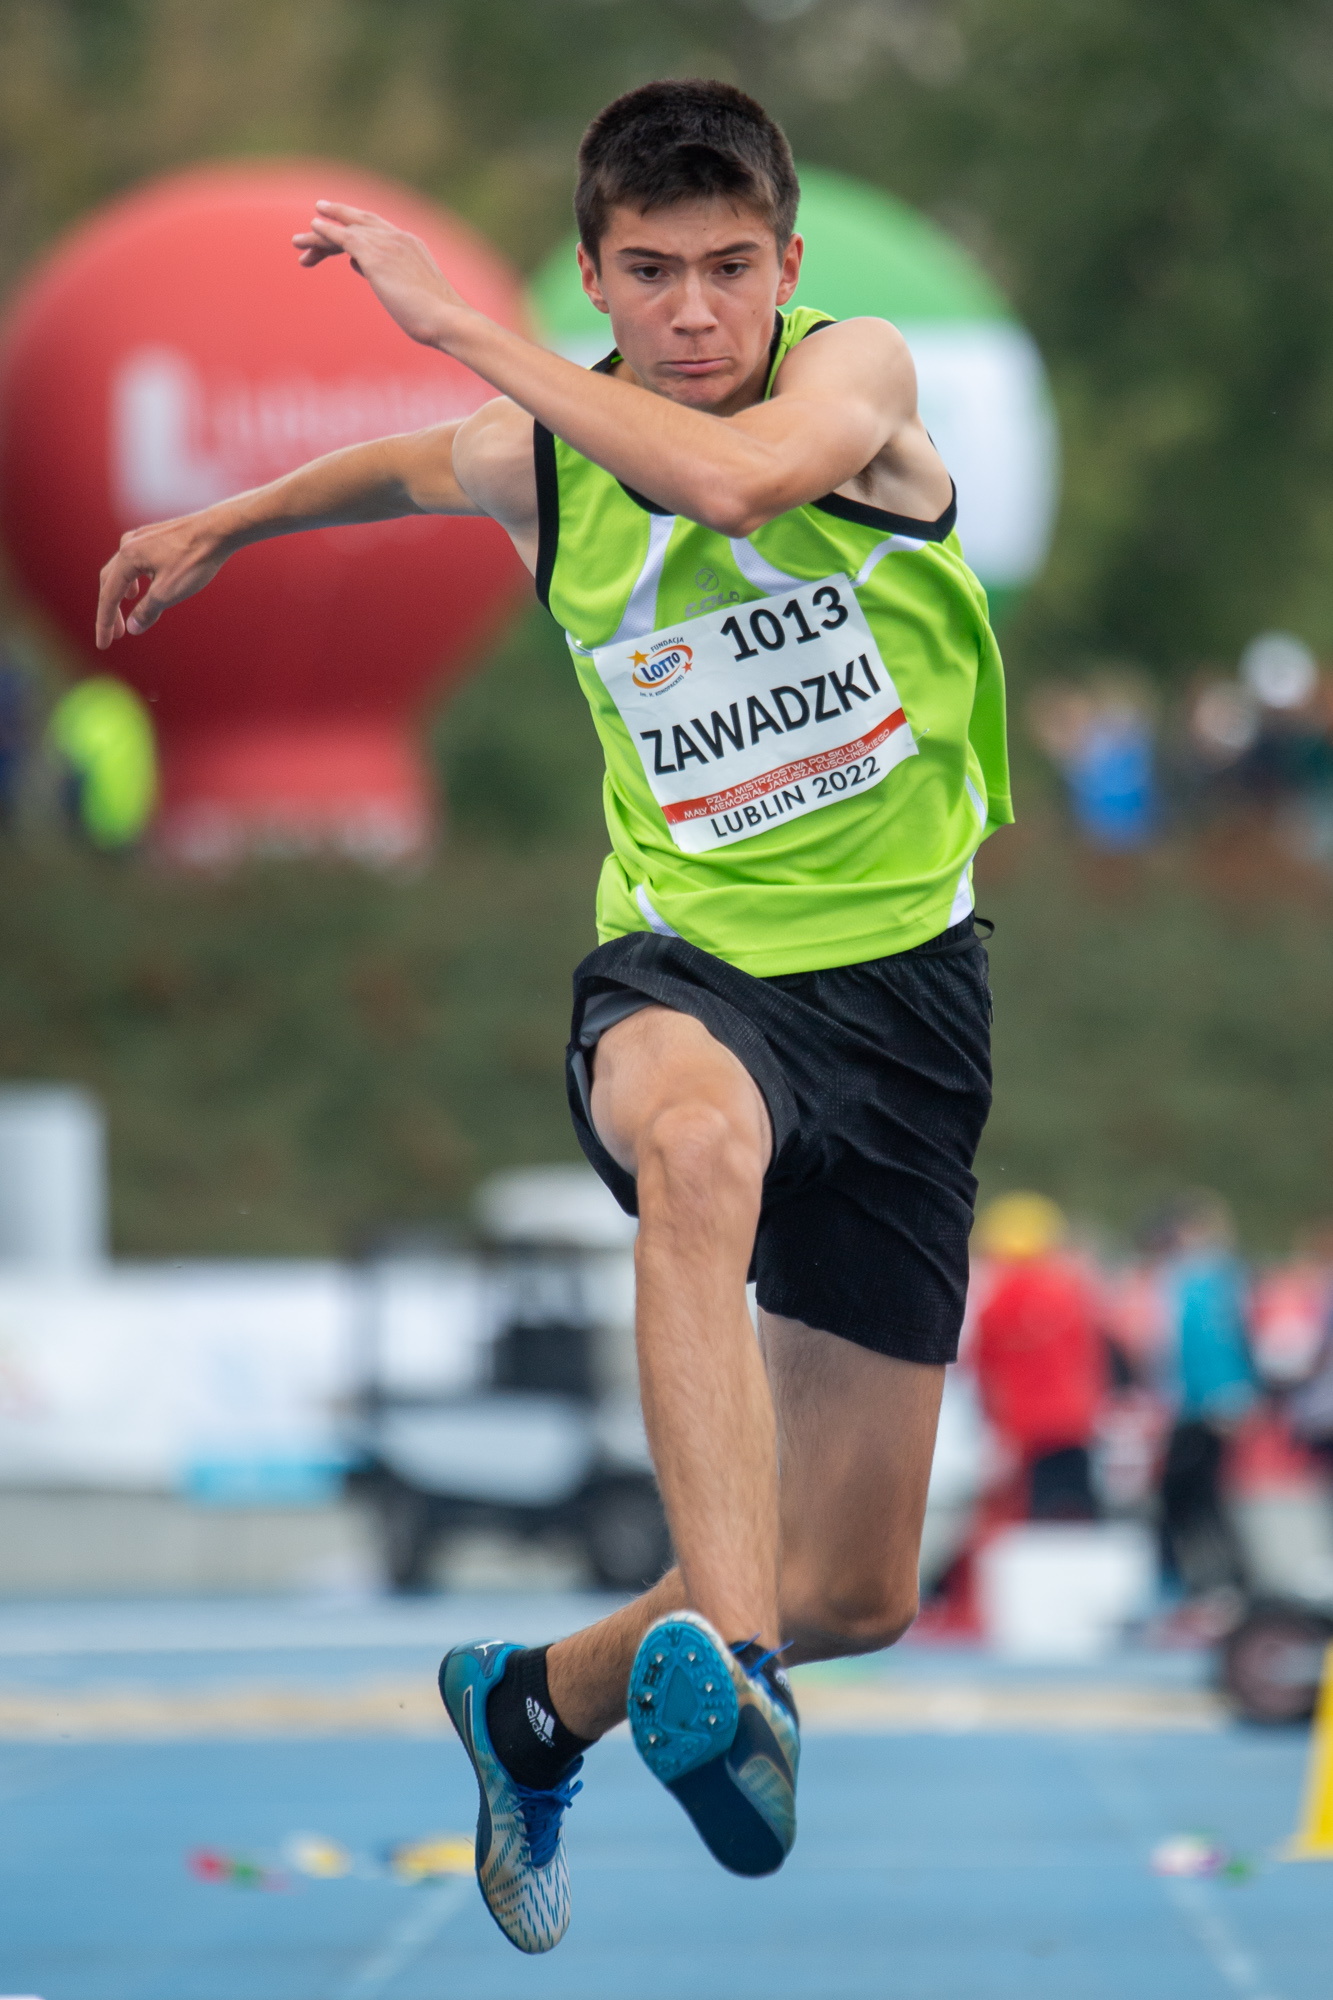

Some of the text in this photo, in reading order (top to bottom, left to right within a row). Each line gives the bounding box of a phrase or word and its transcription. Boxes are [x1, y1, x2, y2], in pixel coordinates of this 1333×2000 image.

[650, 636, 685, 652] FUNDACJA
[721, 586, 849, 662] 1013
[640, 652, 680, 682] LOTTO
[640, 653, 882, 776] ZAWADZKI
[706, 739, 865, 805] PZLA MISTRZOSTWA POLSKI U16
[710, 756, 881, 839] LUBLIN 2022
[767, 767, 816, 792] JANUSZA
